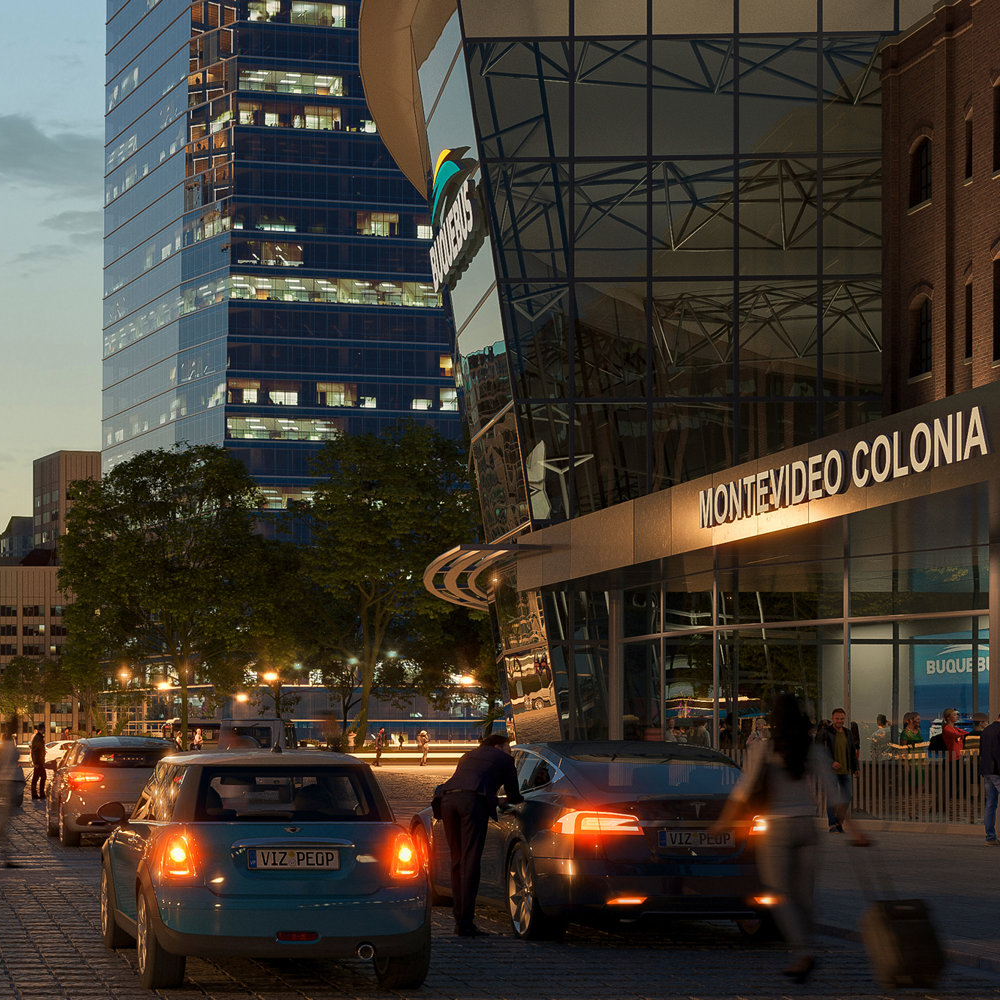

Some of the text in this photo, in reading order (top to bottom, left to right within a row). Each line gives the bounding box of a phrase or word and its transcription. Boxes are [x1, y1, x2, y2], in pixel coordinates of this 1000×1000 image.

[429, 180, 473, 293] BUQUEBUS
[699, 406, 988, 528] MONTEVIDEO COLONIA
[261, 851, 335, 866] VIZ PEOP
[669, 832, 692, 845] VIZ
